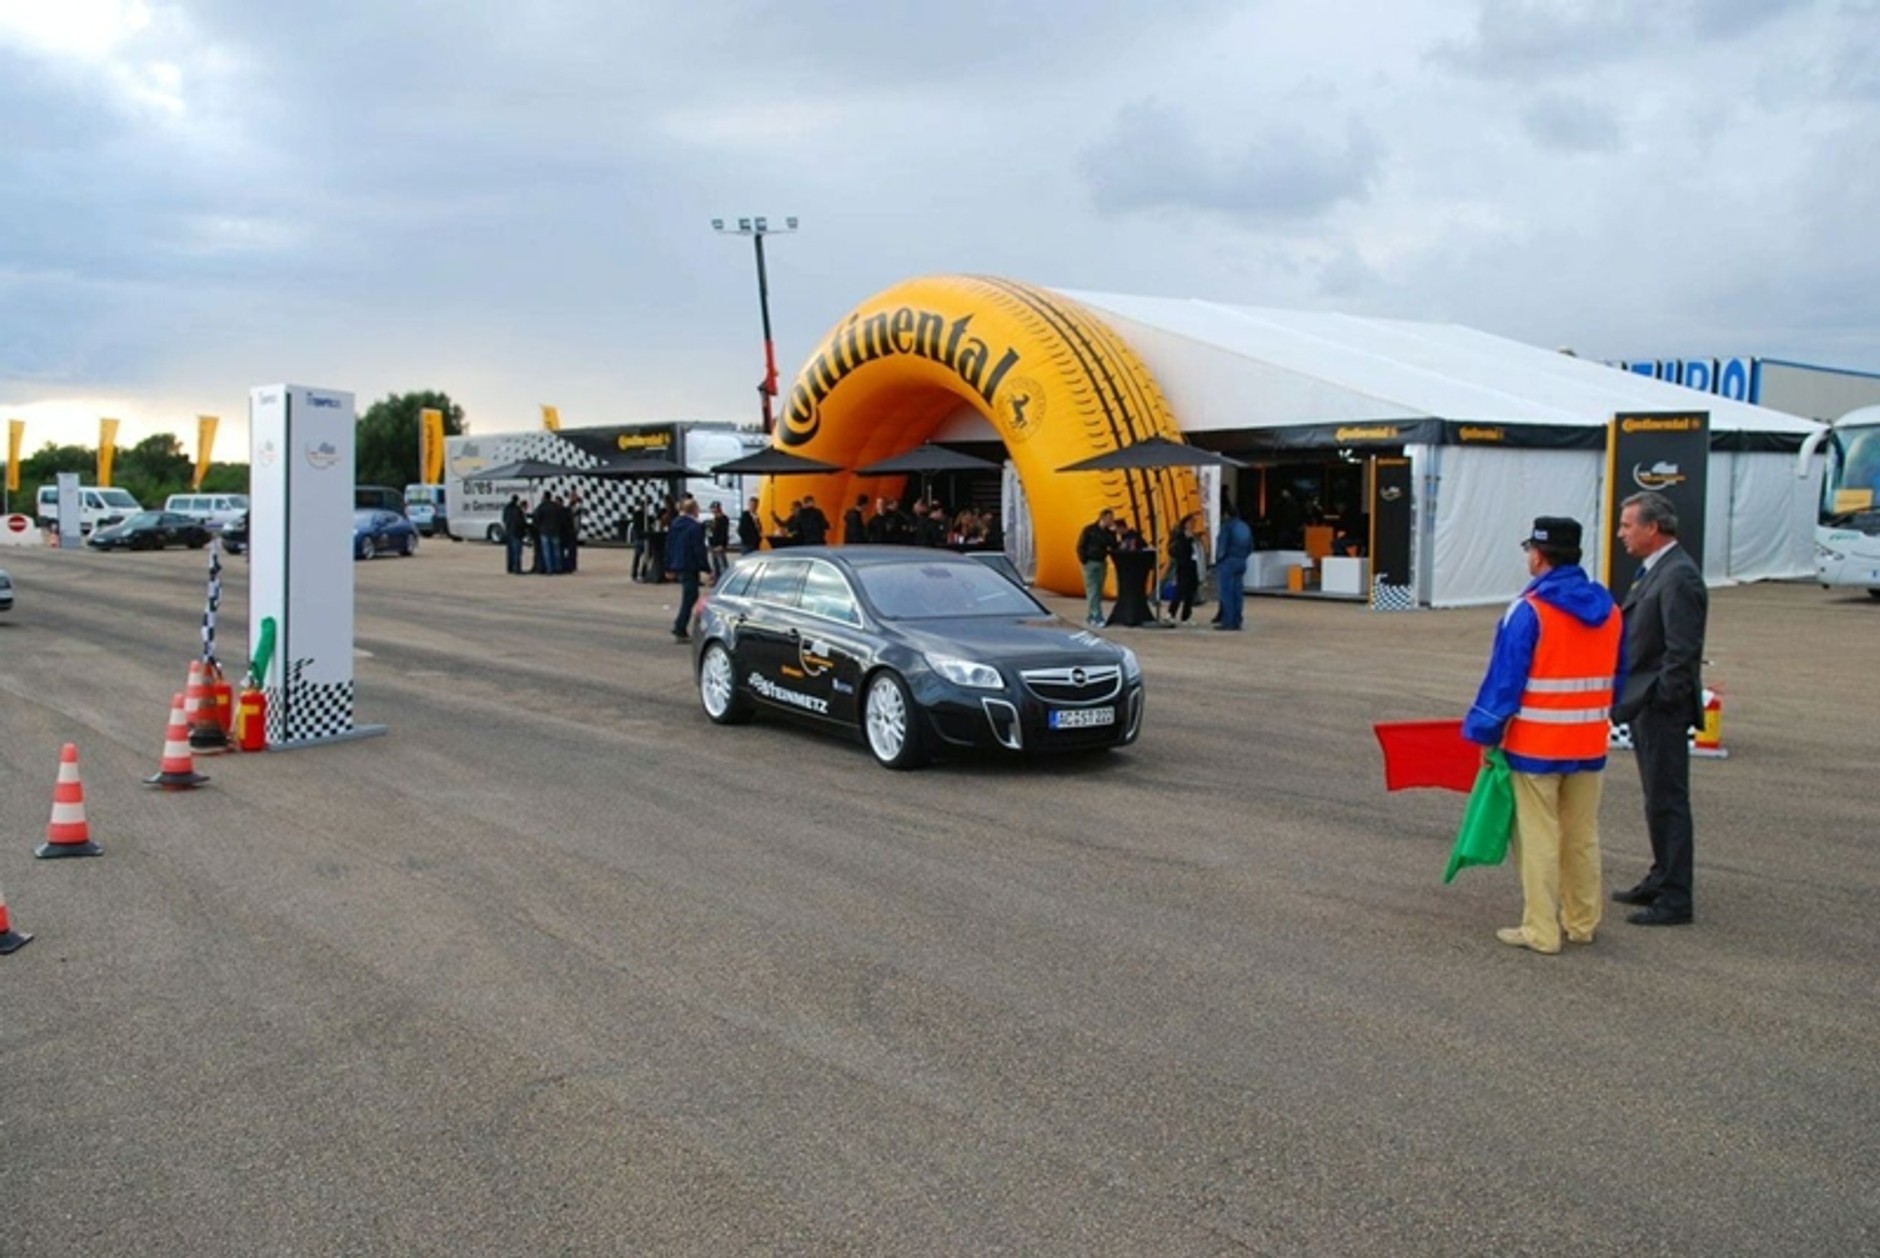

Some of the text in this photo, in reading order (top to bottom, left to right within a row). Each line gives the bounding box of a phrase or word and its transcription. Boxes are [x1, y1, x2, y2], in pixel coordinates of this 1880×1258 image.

[778, 307, 1019, 446] Continental
[1621, 418, 1688, 432] Continental
[618, 433, 663, 450] Continental
[1336, 427, 1389, 442] Continental
